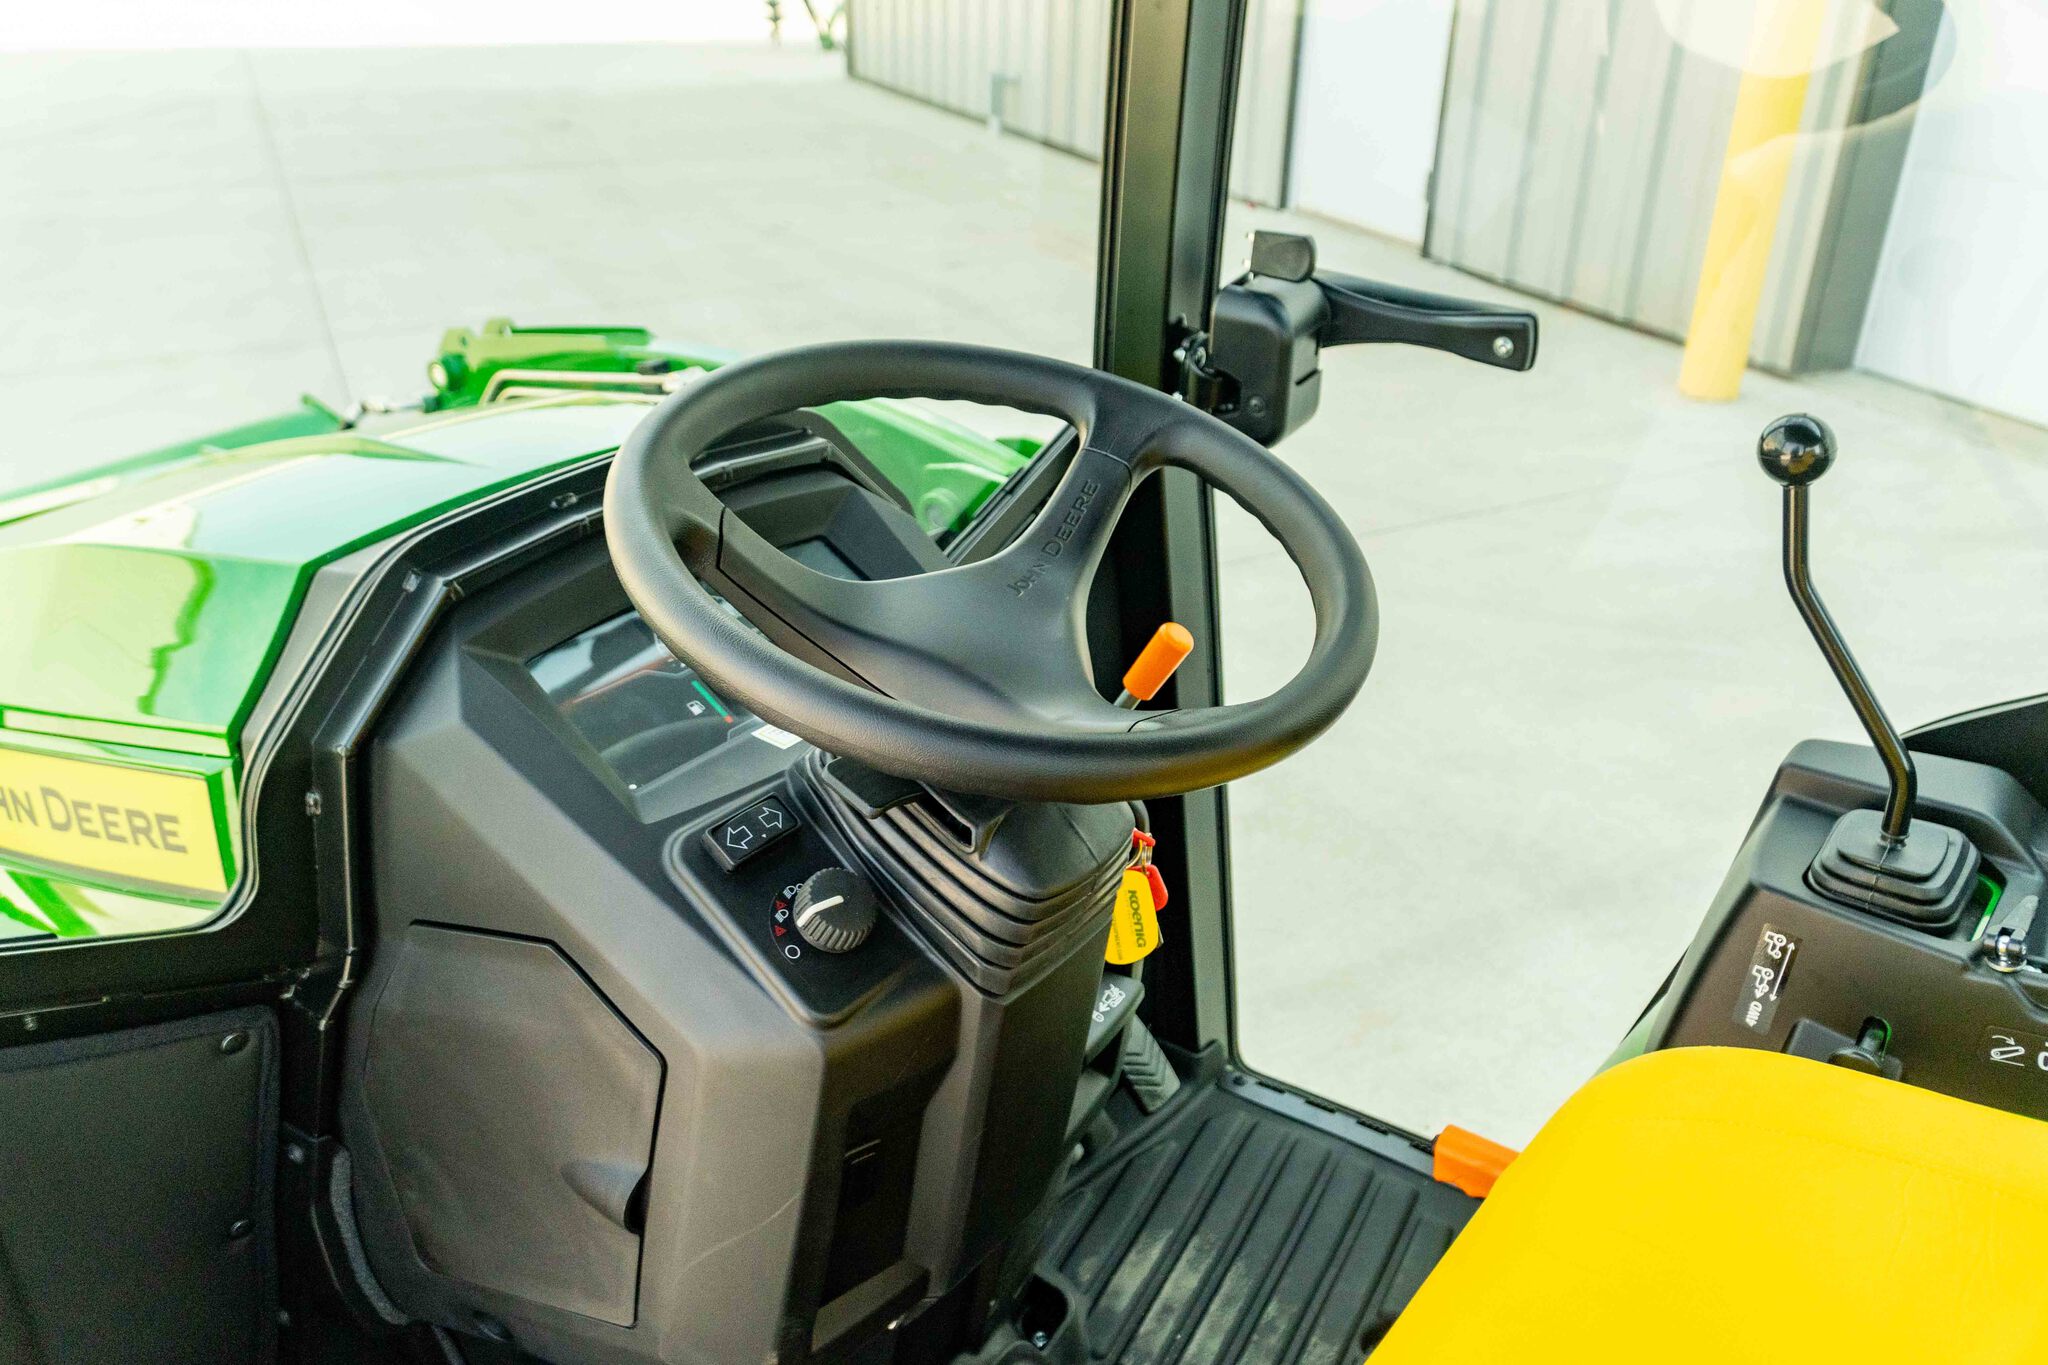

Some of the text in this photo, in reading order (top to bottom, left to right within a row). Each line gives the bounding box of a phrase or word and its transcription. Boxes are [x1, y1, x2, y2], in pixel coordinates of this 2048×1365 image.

[1007, 479, 1101, 597] JOHN DEERE
[40, 785, 188, 853] DEERE
[1745, 1001, 1763, 1028] 4WD
